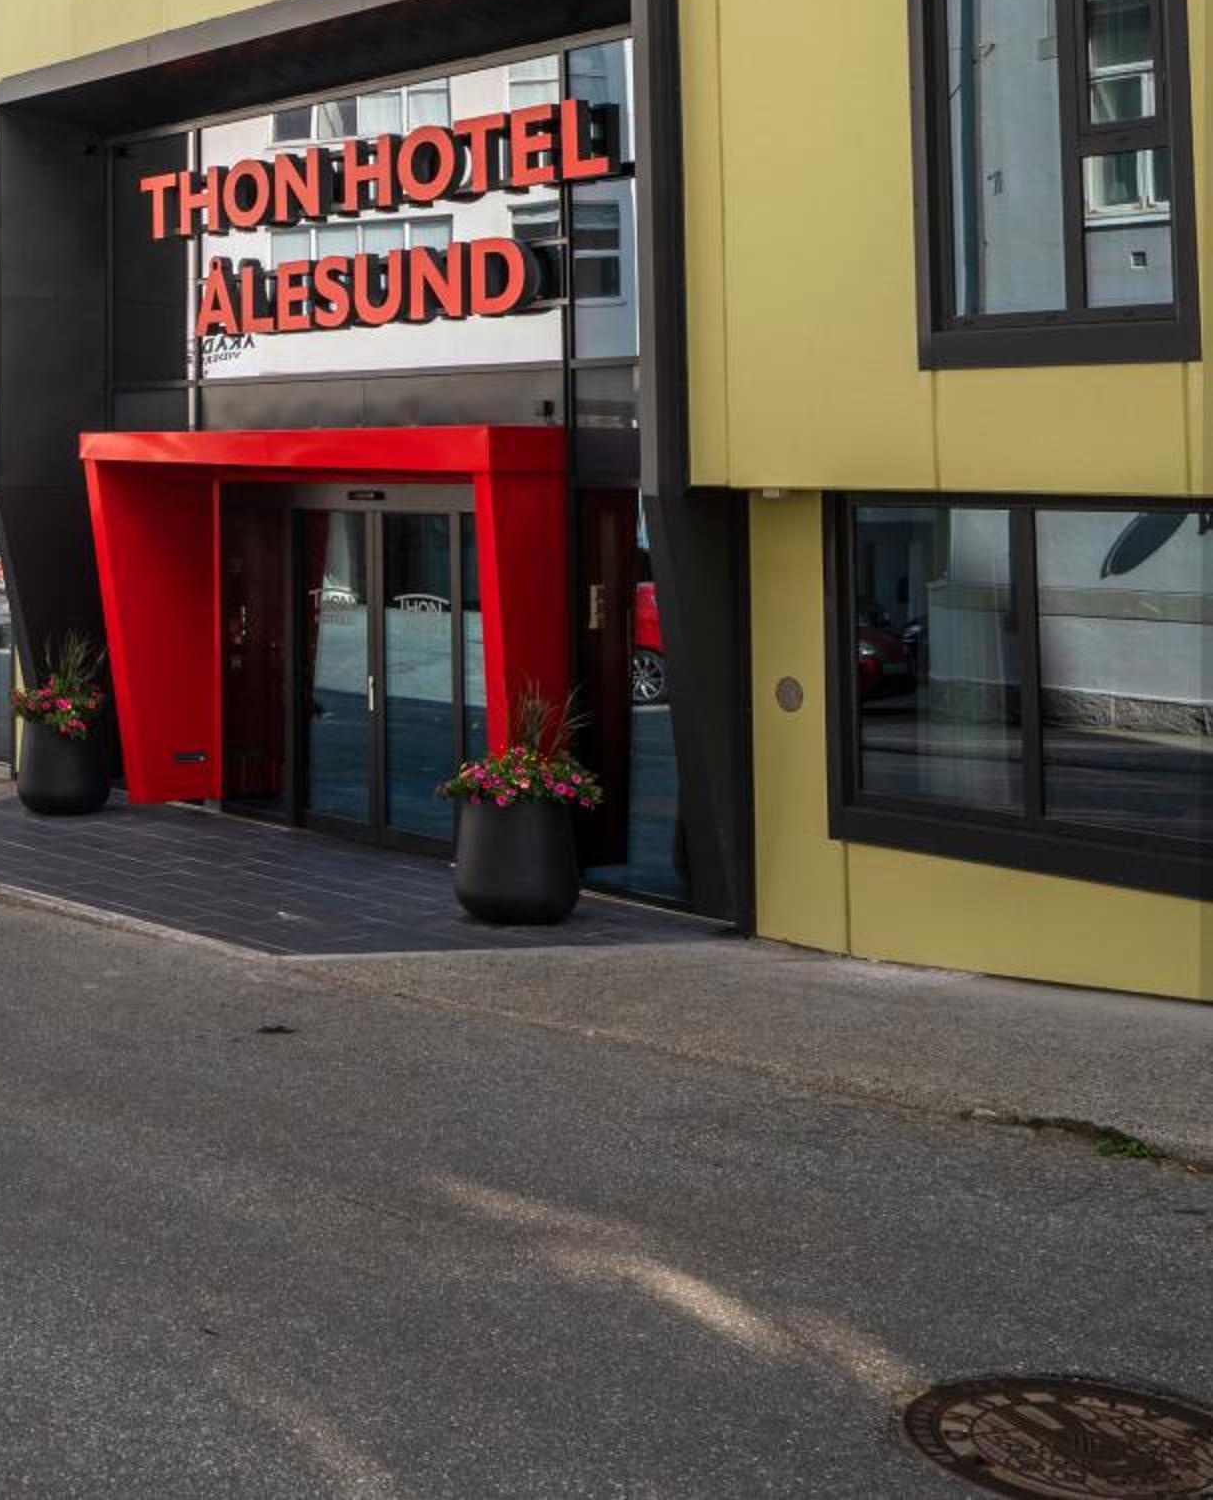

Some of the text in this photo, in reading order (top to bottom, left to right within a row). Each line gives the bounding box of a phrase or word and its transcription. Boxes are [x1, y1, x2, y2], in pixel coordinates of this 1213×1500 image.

[140, 100, 611, 240] THON HOTEL
[196, 238, 528, 336] ÅLESUND
